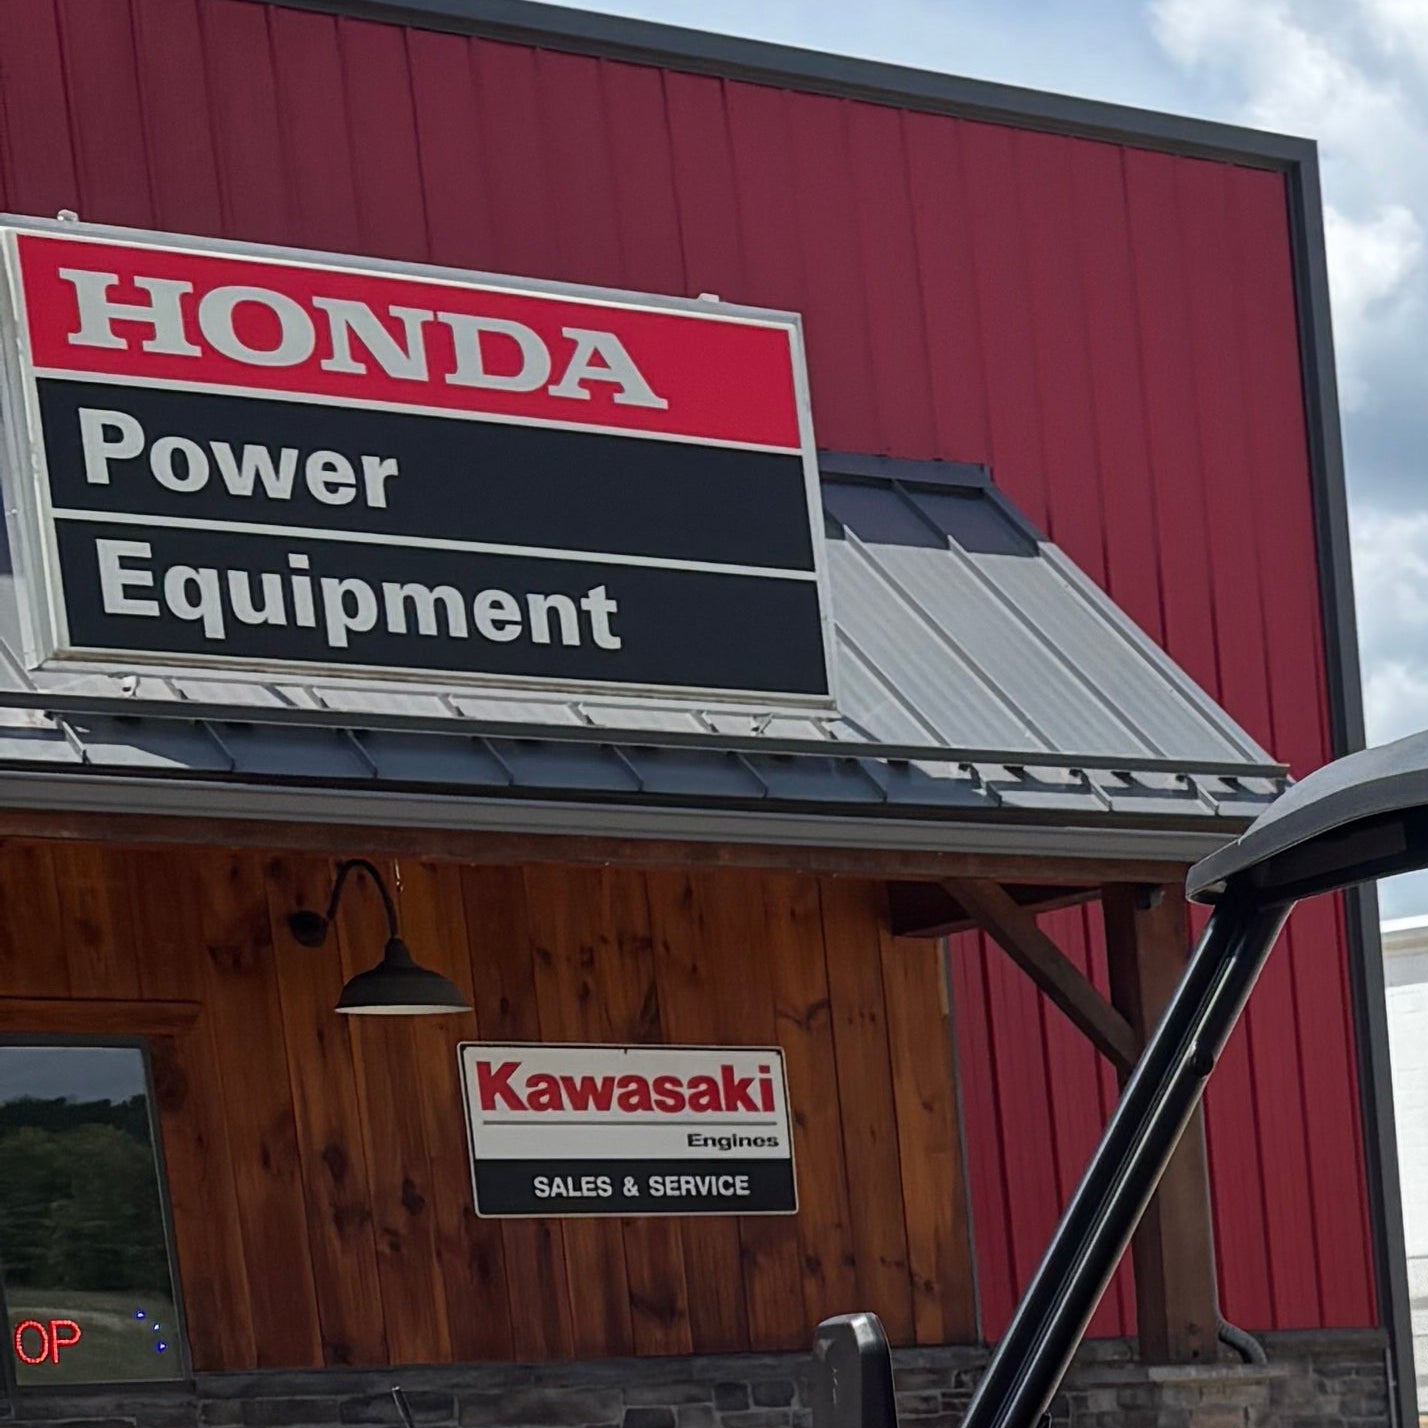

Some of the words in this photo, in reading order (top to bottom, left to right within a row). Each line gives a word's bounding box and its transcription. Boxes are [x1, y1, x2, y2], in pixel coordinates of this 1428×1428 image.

[58, 266, 669, 410] HONDA
[78, 406, 399, 510] Power
[95, 537, 622, 651] Equipment
[475, 1060, 776, 1114] Kawasaki
[687, 1133, 780, 1151] Engines
[533, 1175, 613, 1198] SALES
[622, 1176, 640, 1198] &
[648, 1175, 751, 1198] SERVICE
[15, 1319, 82, 1365] OP
